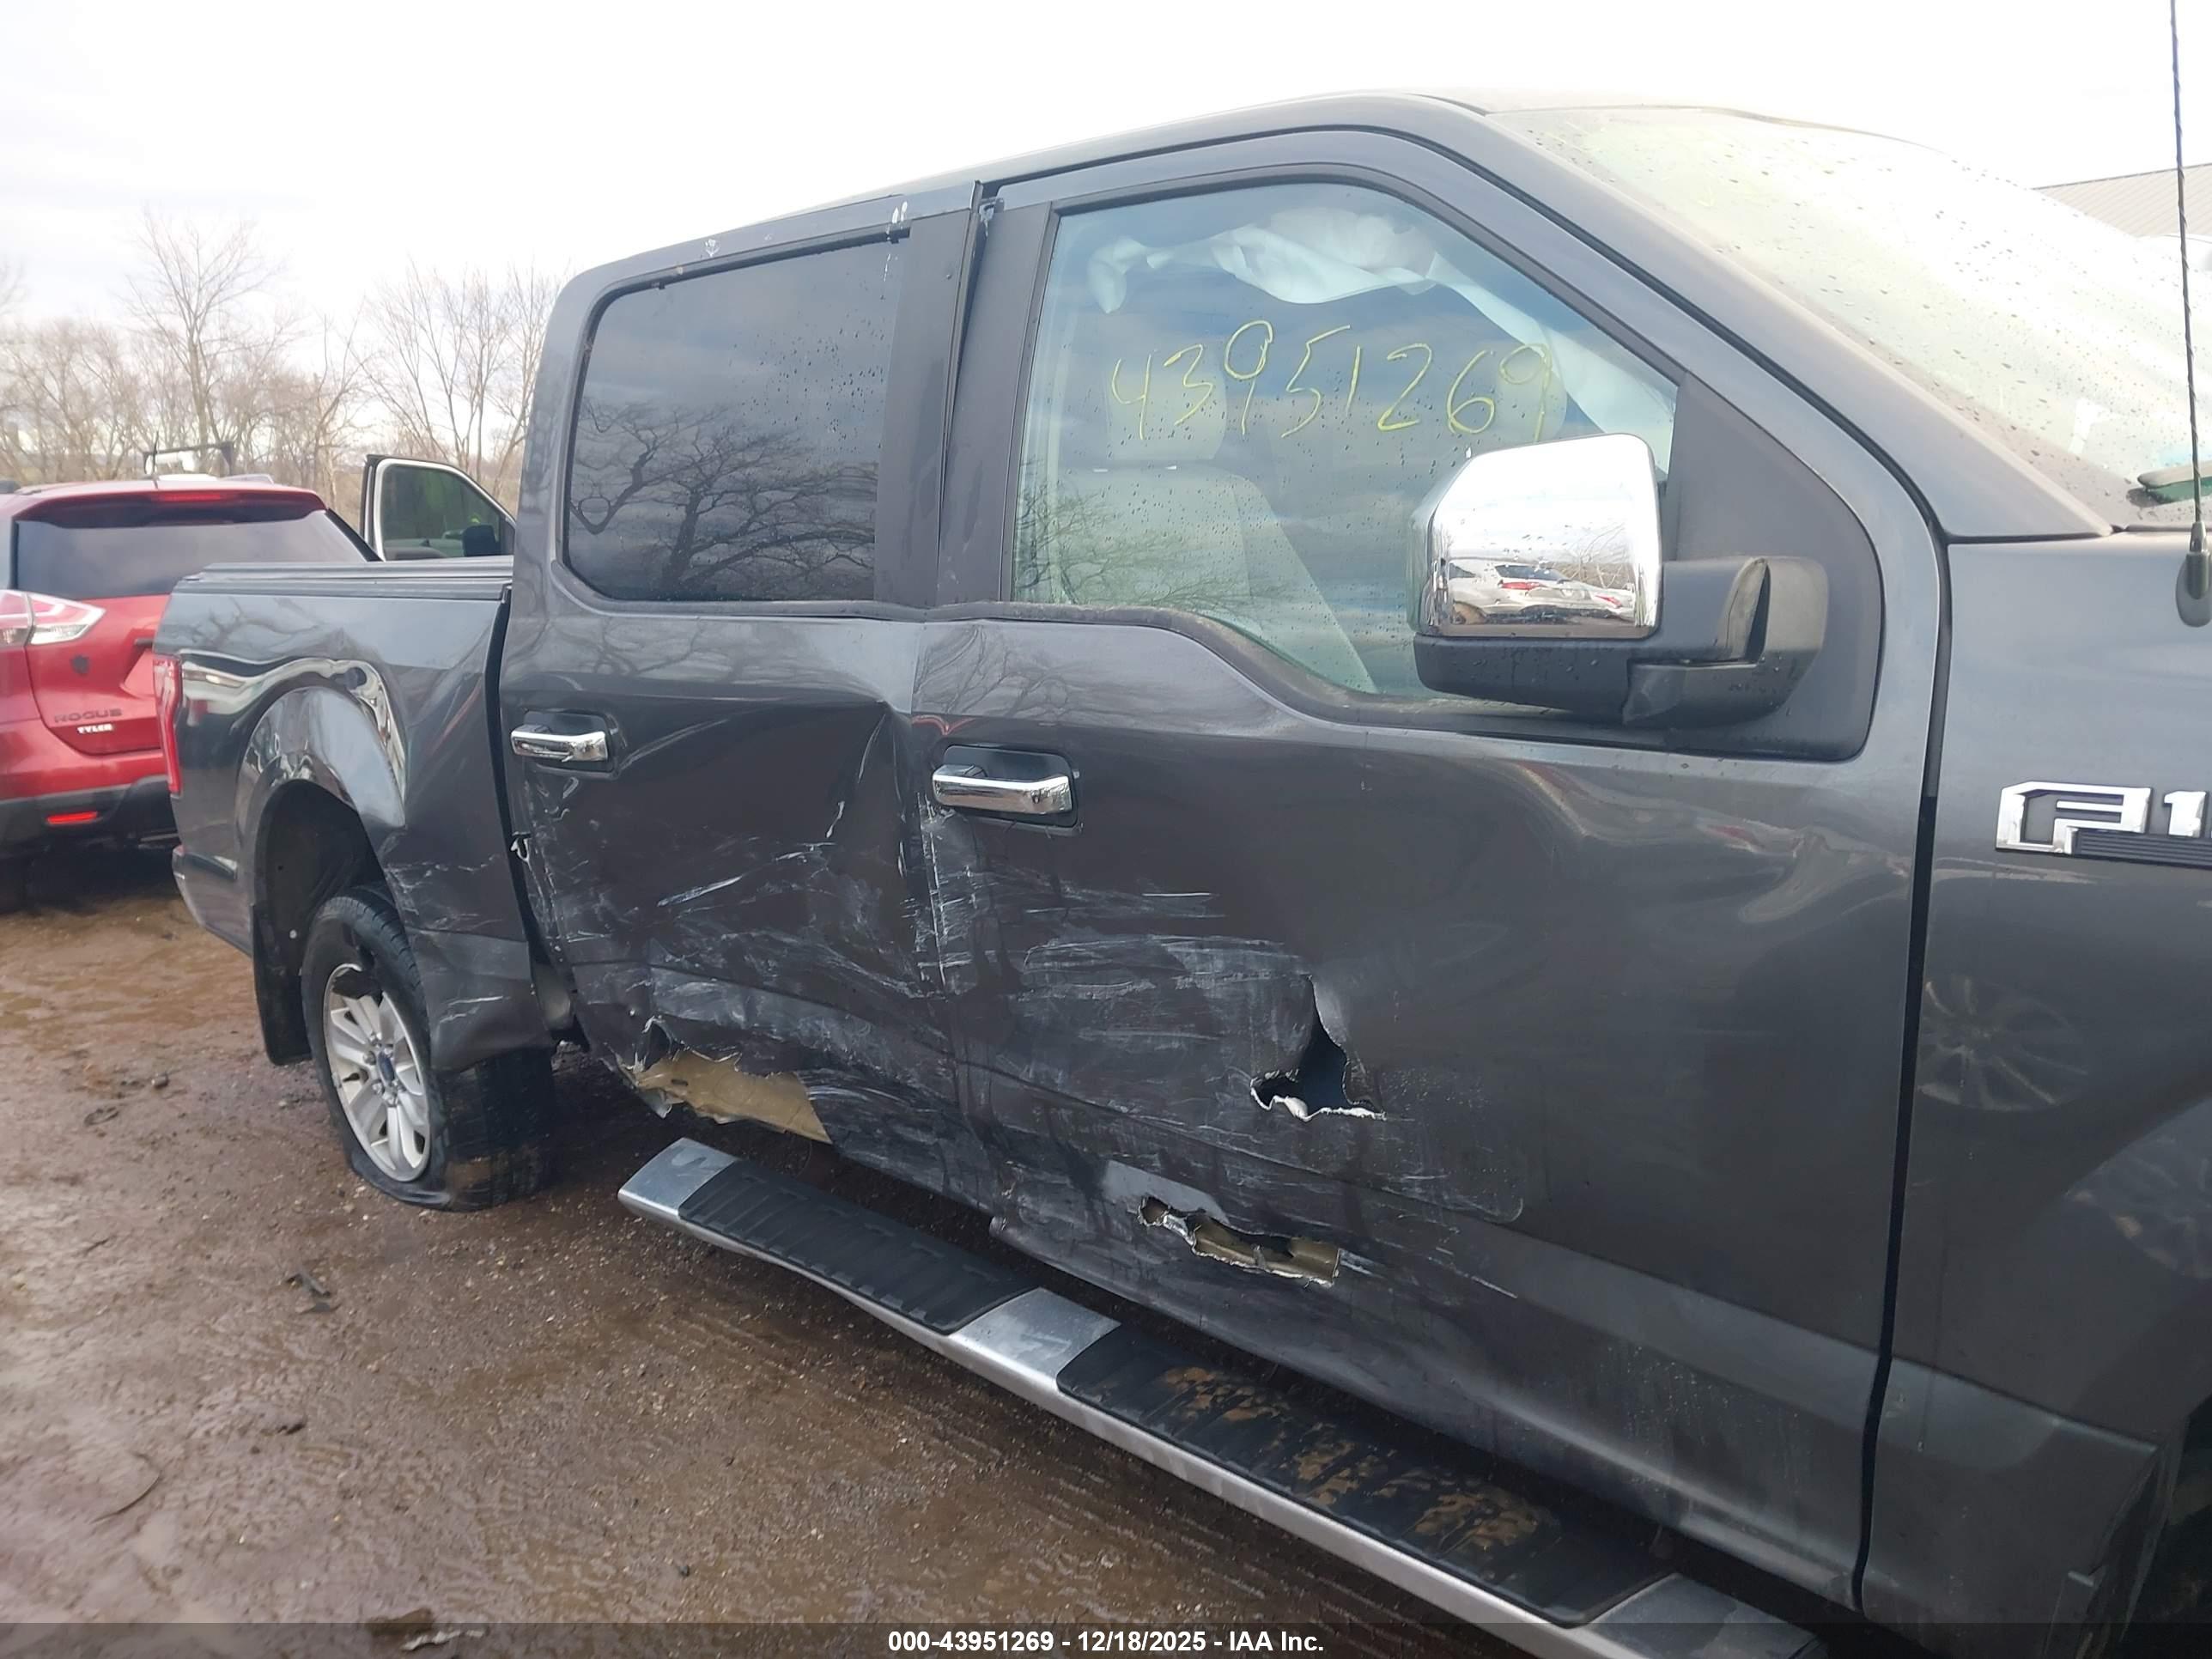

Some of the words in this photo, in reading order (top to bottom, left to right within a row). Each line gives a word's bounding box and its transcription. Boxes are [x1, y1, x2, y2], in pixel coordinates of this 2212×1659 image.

[1112, 320, 1552, 441] 43951269
[54, 708, 123, 723] ROGUE
[1996, 781, 2212, 855] F1
